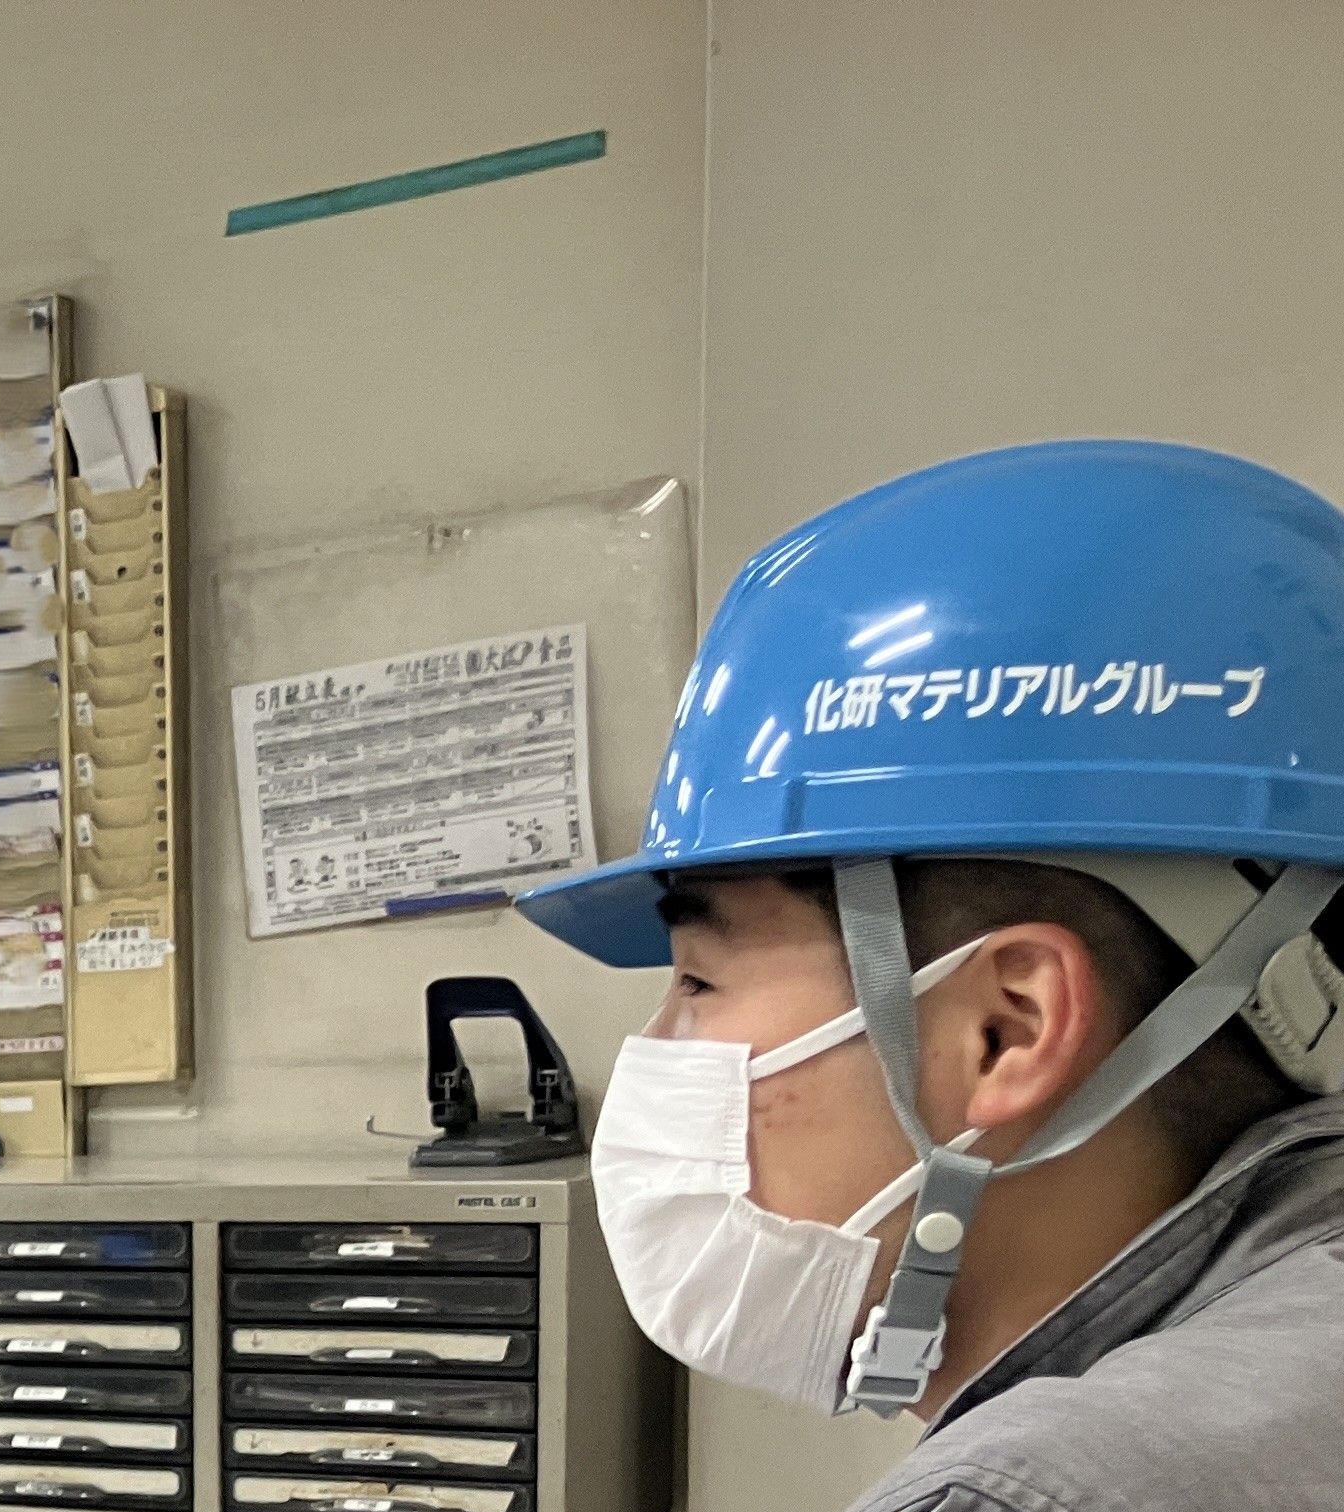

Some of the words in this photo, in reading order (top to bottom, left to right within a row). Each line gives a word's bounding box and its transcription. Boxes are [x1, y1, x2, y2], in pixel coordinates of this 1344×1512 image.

[804, 661, 1265, 735] 化研マテリアルグループ
